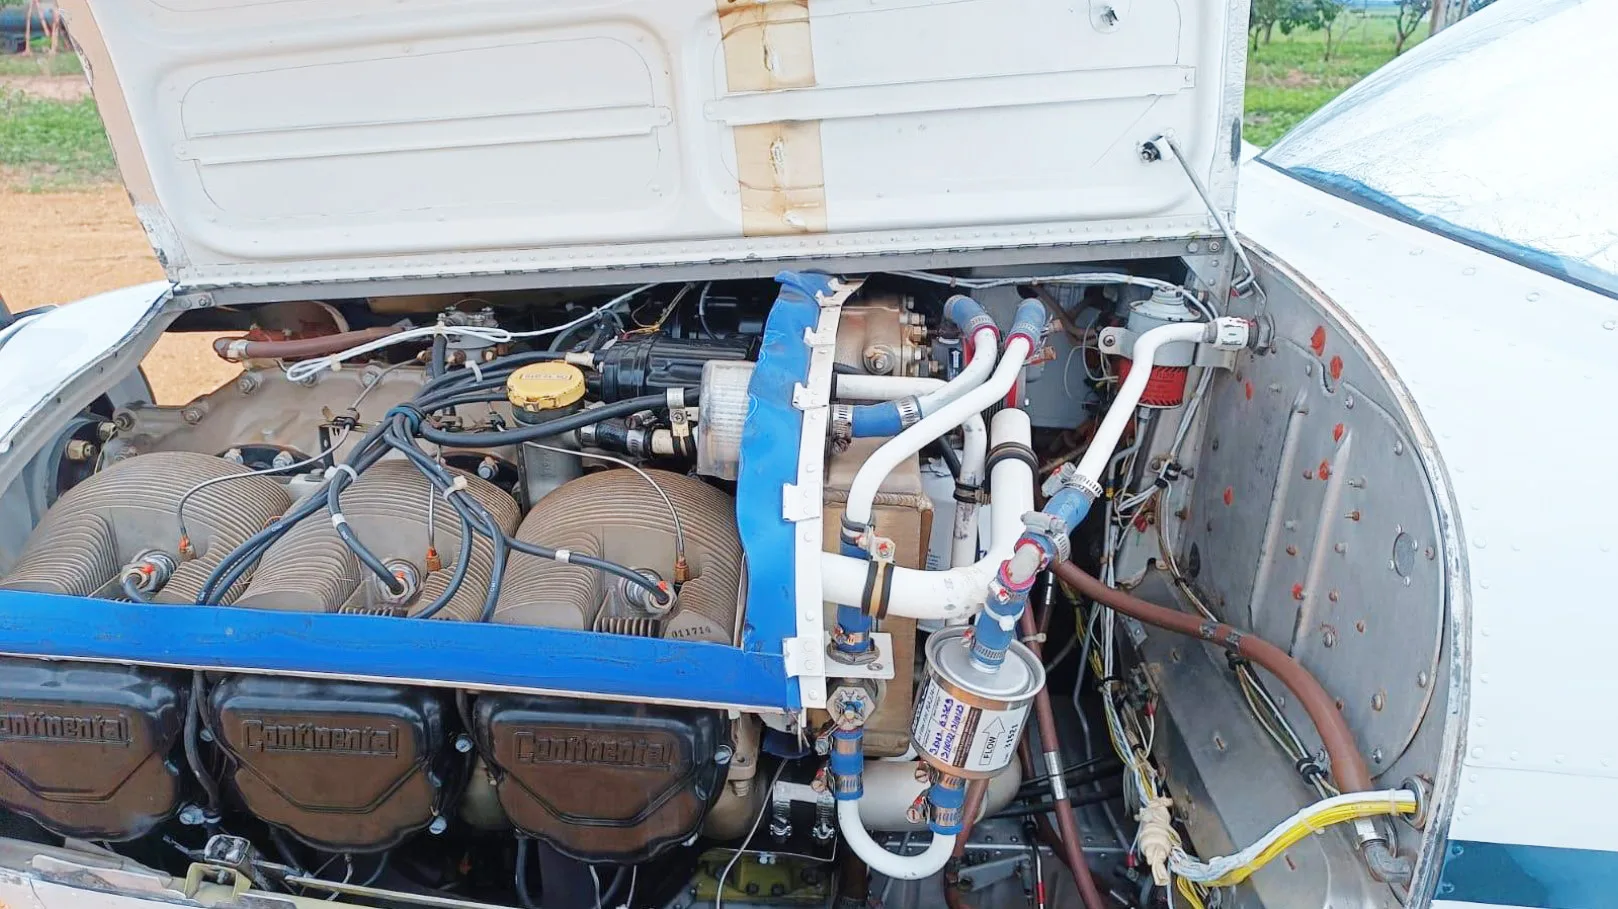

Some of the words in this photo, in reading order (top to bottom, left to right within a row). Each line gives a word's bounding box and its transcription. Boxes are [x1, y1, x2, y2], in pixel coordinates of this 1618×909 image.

[0, 712, 130, 743] ontinental
[242, 719, 399, 758] Continental
[513, 731, 674, 769] Continental
[983, 736, 997, 759] FLOW
